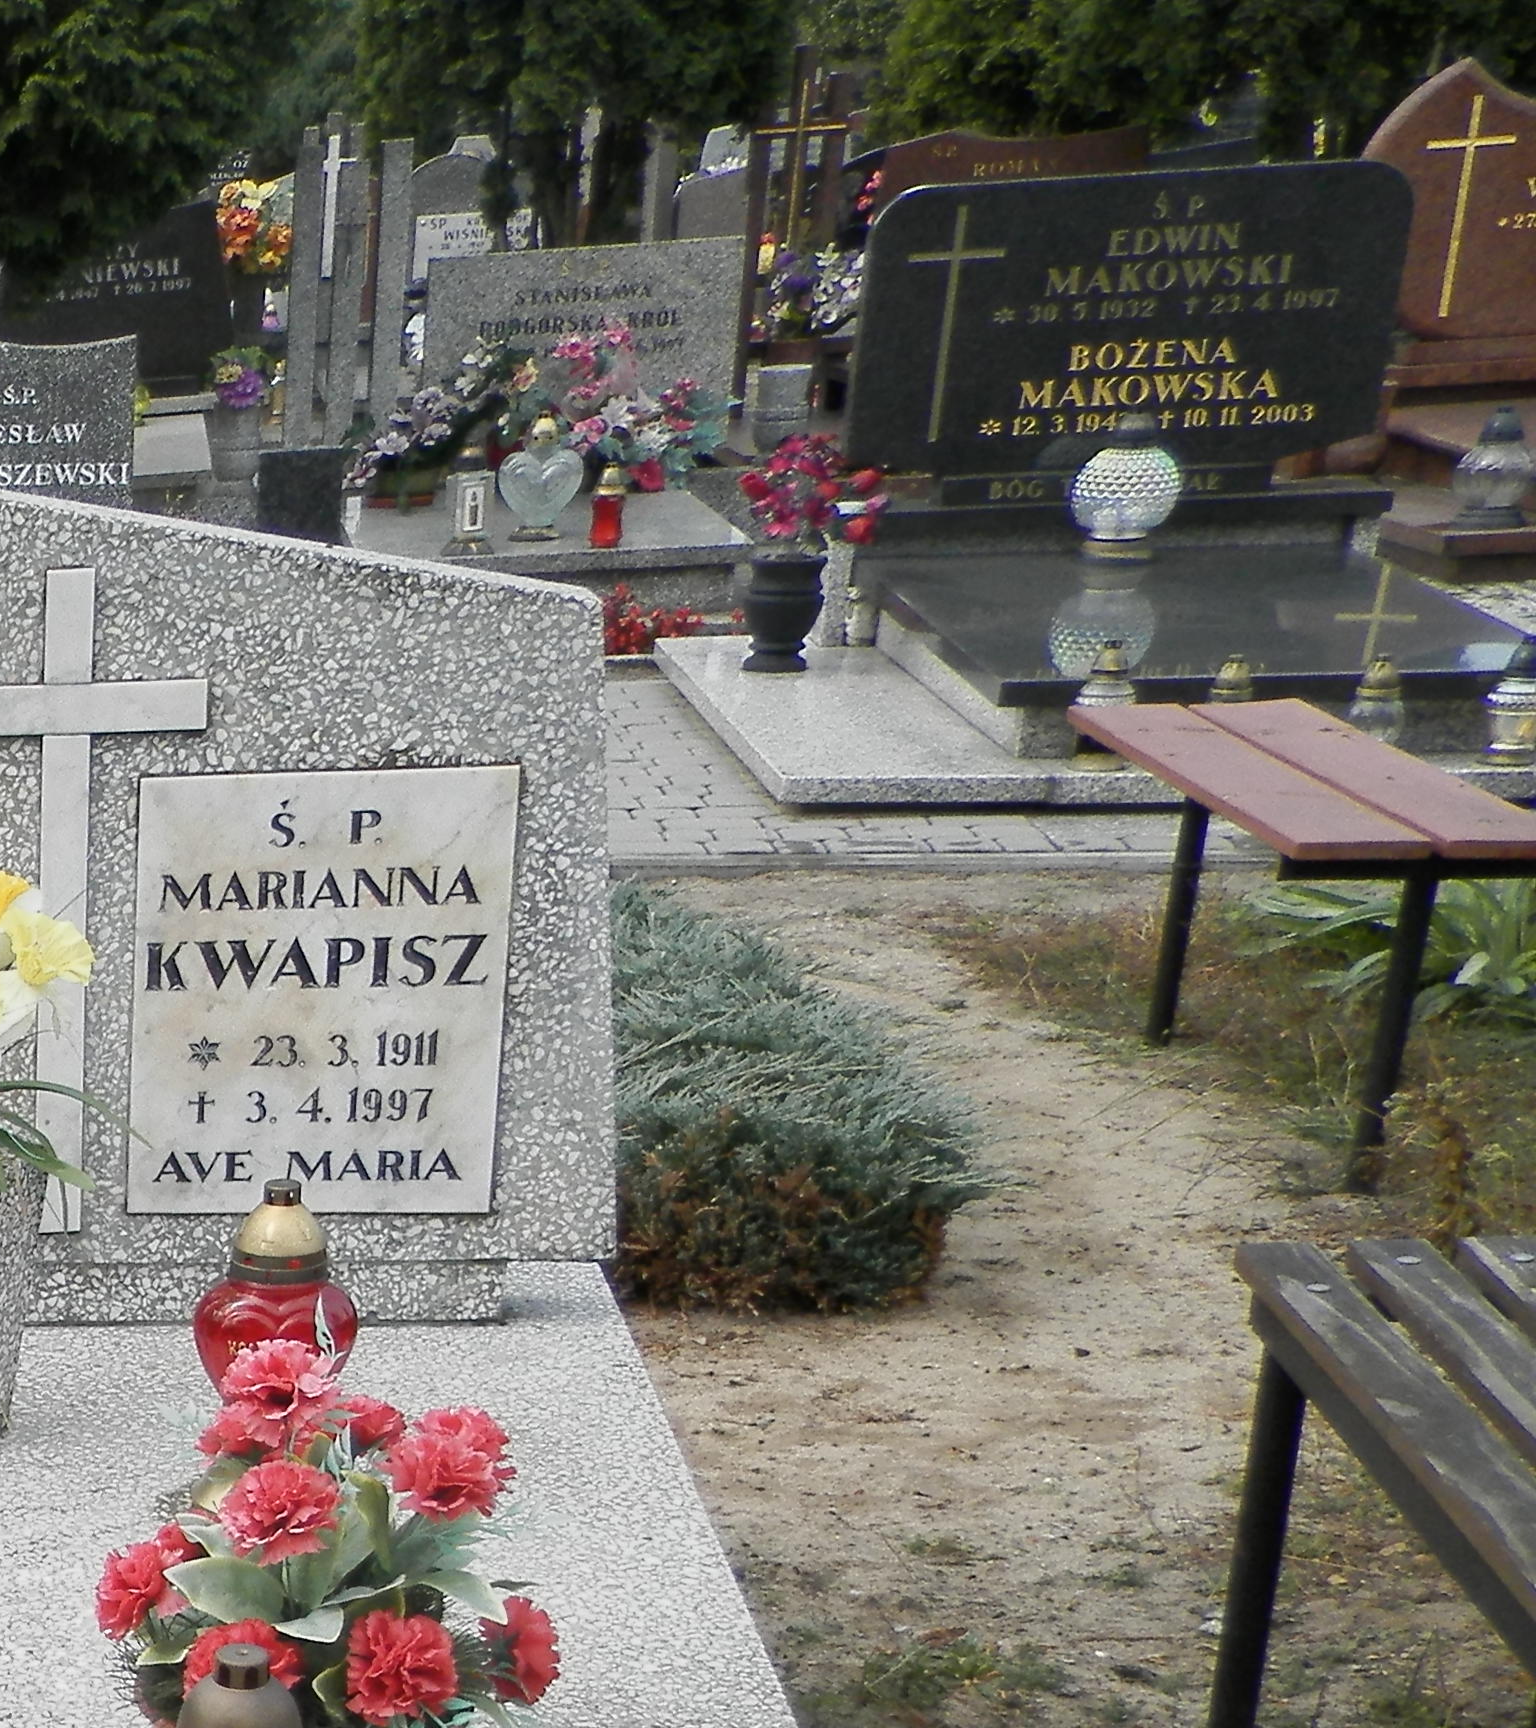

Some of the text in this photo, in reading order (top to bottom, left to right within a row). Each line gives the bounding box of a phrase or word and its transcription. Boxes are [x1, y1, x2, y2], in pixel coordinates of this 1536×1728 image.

[1105, 222, 1243, 257] EDWIN
[1044, 254, 1295, 297] MAKOWSKI
[1067, 337, 1240, 372] BOŻENA
[1018, 368, 1280, 409] MAKOWSKA
[1250, 404, 1316, 425] 2003
[268, 799, 384, 848] Ś. P.
[157, 863, 483, 913] MARIANNA
[144, 933, 489, 992] KWAPISZ
[250, 1034, 306, 1068] 23.
[376, 1028, 440, 1067] 1911
[152, 1148, 462, 1184] AVE MARIA
